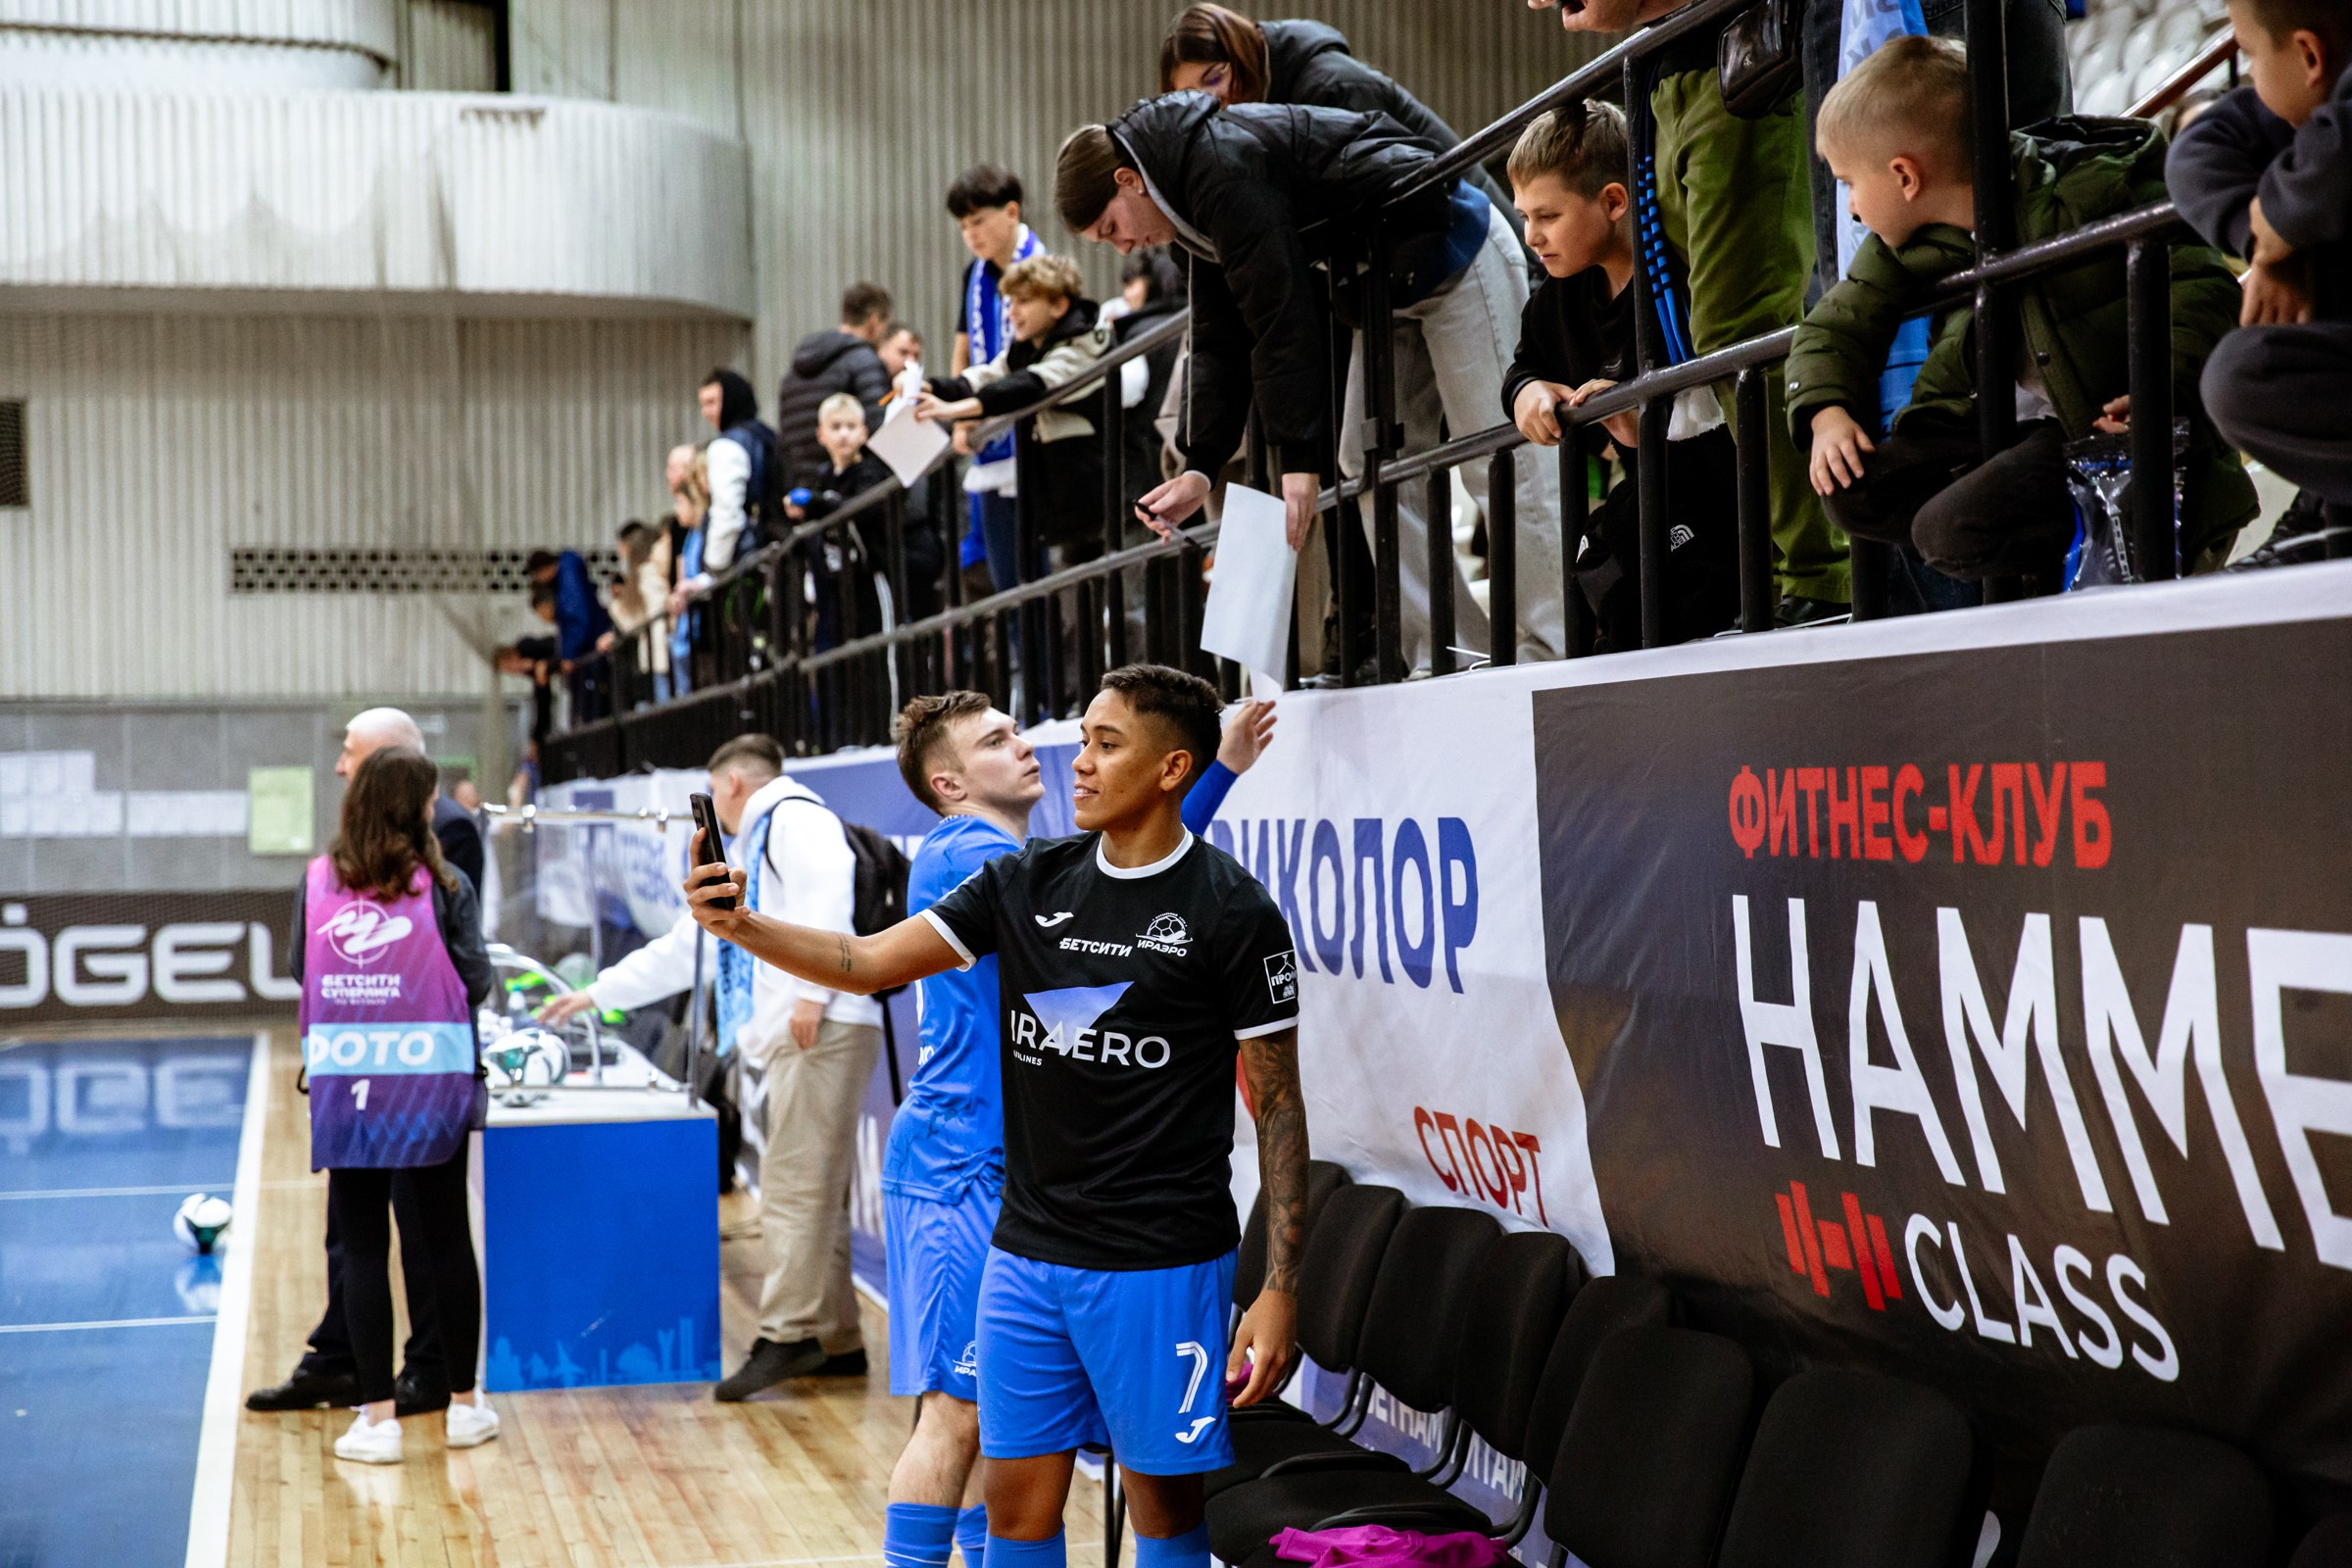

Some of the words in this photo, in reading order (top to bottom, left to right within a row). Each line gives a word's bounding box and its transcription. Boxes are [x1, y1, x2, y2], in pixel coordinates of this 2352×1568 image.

[1729, 760, 2112, 869] ФИТНЕС-КЛУБ
[1211, 816, 1480, 994] ИКОЛОР
[321, 973, 402, 987] БЕТСИТИ
[1059, 937, 1133, 957] БЕТСИТИ
[1137, 939, 1187, 957] ИРАЭРО
[1010, 1009, 1171, 1069] IRAERO
[350, 1079, 370, 1110] 1
[1414, 1105, 1549, 1229] СПОРТ
[1904, 1212, 2180, 1382] CLASS
[1176, 1341, 1207, 1413] 7
